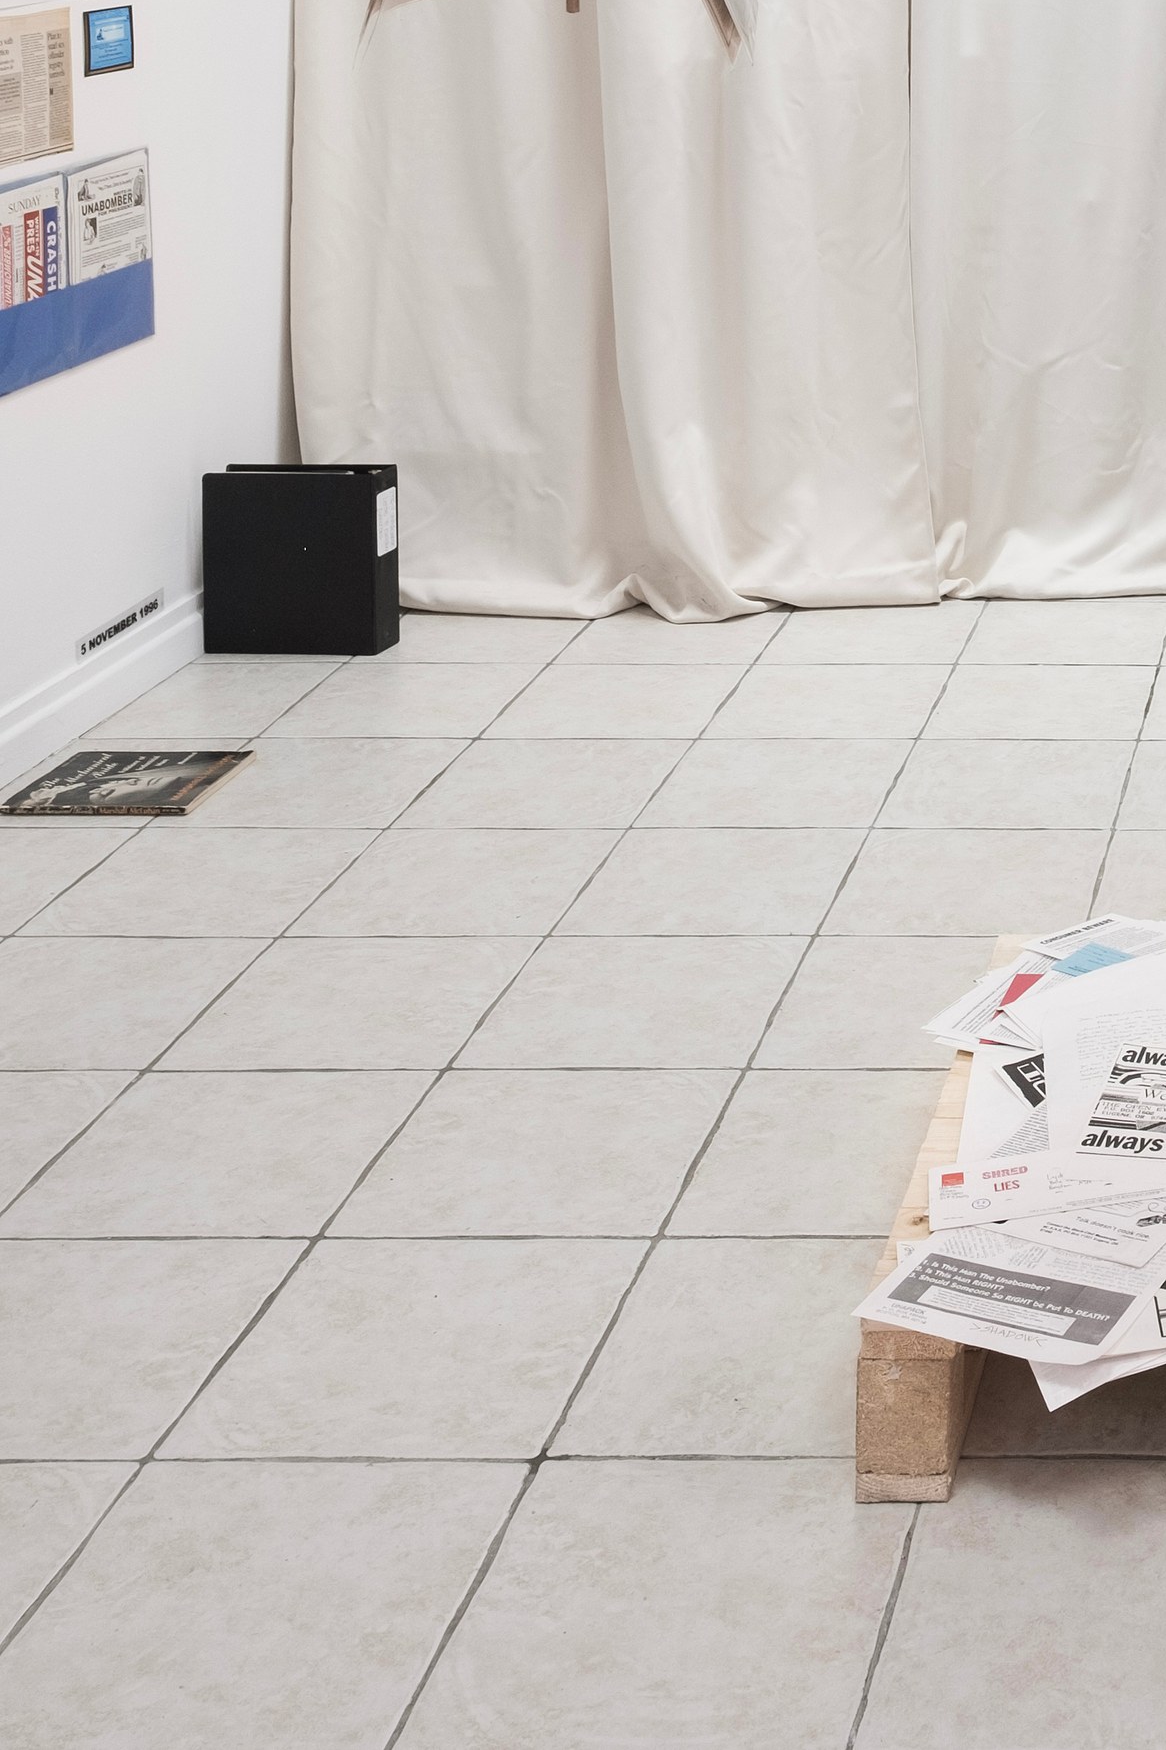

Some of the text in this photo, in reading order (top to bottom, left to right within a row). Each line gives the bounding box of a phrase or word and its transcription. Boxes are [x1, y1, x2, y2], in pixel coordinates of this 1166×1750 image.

[8, 195, 41, 214] SUNDAY
[81, 192, 133, 216] UNABOMBER
[26, 219, 35, 254] PRES
[46, 220, 57, 291] CRASH
[80, 598, 159, 655] 5 NOVEMBER 1996
[1039, 929, 1082, 945] CONSUMER
[1080, 1130, 1164, 1154] always
[981, 1165, 1029, 1180] SHRED
[993, 1179, 1021, 1192] LIES
[925, 1267, 932, 1275] Is
[934, 1270, 952, 1280] This
[953, 1275, 971, 1285] Man
[971, 1279, 1005, 1291] RIGHT?
[931, 1260, 939, 1268] Is
[941, 1263, 958, 1272] This
[959, 1268, 977, 1277] Man
[979, 1272, 995, 1282] The
[996, 1275, 1051, 1293] Unabomber?
[918, 1274, 951, 1287] Should
[950, 1282, 991, 1298] Someone
[991, 1291, 1003, 1300] So
[1004, 1293, 1034, 1306] RIGHT
[1032, 1299, 1045, 1309] be
[1045, 1303, 1062, 1313] Put
[1063, 1306, 1075, 1314] To
[1074, 1308, 1111, 1322] DEATH?
